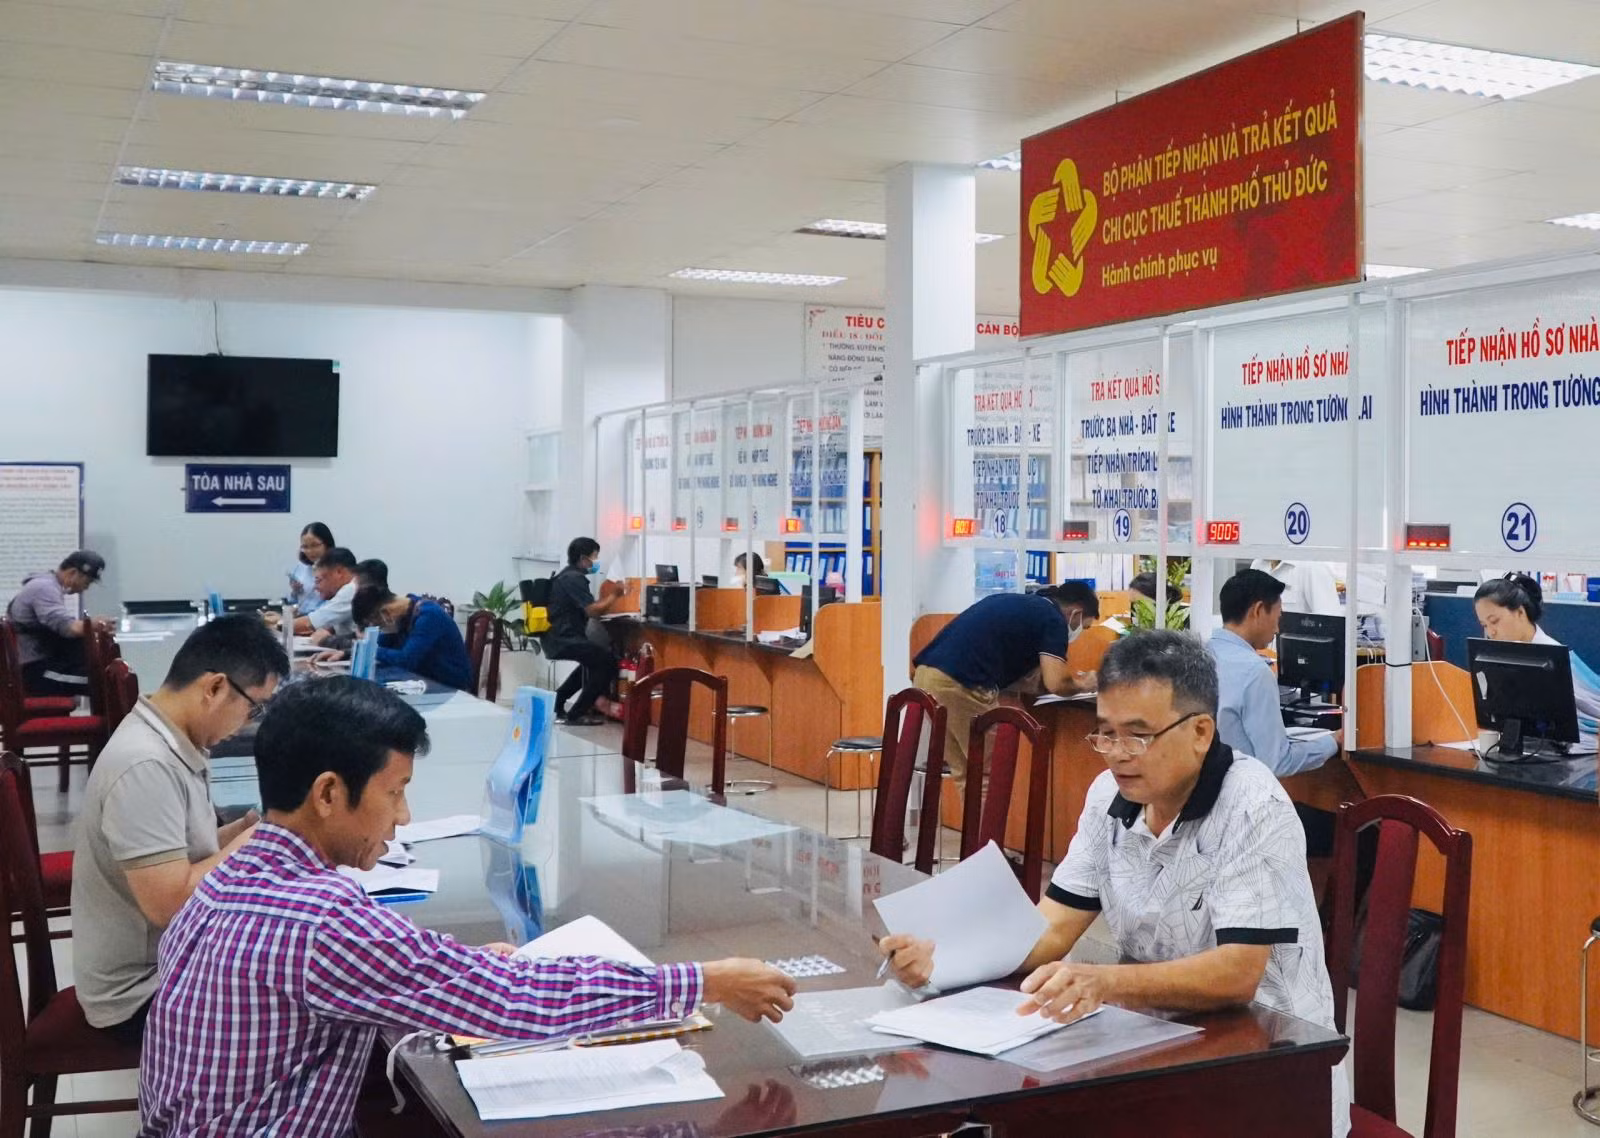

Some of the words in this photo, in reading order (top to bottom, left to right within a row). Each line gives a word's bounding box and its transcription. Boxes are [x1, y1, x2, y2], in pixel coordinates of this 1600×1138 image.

[1103, 161, 1119, 202] BỘ
[1121, 153, 1152, 195] PHẬN
[1154, 137, 1181, 181] TIẾP
[1183, 132, 1218, 176] NHẬN
[1221, 122, 1239, 161] VÀ
[1242, 109, 1270, 155] TRẢ
[1273, 99, 1302, 147] KẾT
[1304, 87, 1338, 137] QUẢ
[1102, 216, 1121, 245] CHI
[1123, 208, 1148, 246] CỤC
[1150, 186, 1182, 233] THUẾ
[1184, 183, 1228, 224] THÀNH
[1231, 163, 1260, 213] PHỐ
[1263, 159, 1292, 204] THỦ
[1295, 153, 1328, 197] ĐỨC
[1102, 260, 1131, 288] Hành
[1133, 253, 1166, 281] chính
[1168, 248, 1200, 279] phục
[1202, 246, 1218, 271] vụ
[1445, 327, 1476, 366] TIẾP
[1480, 327, 1517, 367] NHẬN
[1521, 317, 1540, 359] HỒ
[1545, 323, 1565, 357] SƠ
[1569, 316, 1599, 354] NHÀ
[1242, 353, 1263, 386] TIẾP
[1266, 352, 1292, 386] NHẬN
[1296, 345, 1310, 380] HỒ
[1313, 349, 1327, 377] SƠ
[1091, 372, 1105, 402] TRẢ
[1107, 371, 1122, 400] KẾT
[1124, 368, 1139, 400] QUẢ
[1142, 365, 1153, 396] HỒ
[1420, 383, 1450, 416] HÌNH
[1453, 379, 1498, 414] THÀNH
[1502, 380, 1548, 411] TRONG
[1553, 373, 1600, 408] TƯƠNG
[1081, 412, 1104, 439] TRƯỚC
[1106, 417, 1117, 441] BẠ
[1119, 410, 1134, 436] NHÀ
[1141, 405, 1157, 435] ĐẤT
[1221, 401, 1243, 429] HÌNH
[1246, 398, 1277, 428] THÀNH
[1280, 400, 1313, 426] TRONG
[1358, 395, 1372, 420] AI
[1033, 423, 1040, 442] XE
[1087, 447, 1103, 474] TIẾP
[1105, 448, 1126, 477] NHẬN
[1128, 446, 1150, 472] TRÍCH
[192, 472, 220, 491] TÒA
[224, 472, 253, 491] NHÀ
[257, 475, 285, 491] SAU
[1104, 488, 1121, 508] KHAI
[1123, 484, 1149, 508] TRƯỚC
[995, 515, 1006, 533] 18
[1116, 516, 1130, 537] 19
[1210, 523, 1239, 540] 9005
[1287, 510, 1307, 536] 20
[1506, 512, 1531, 541] 21
